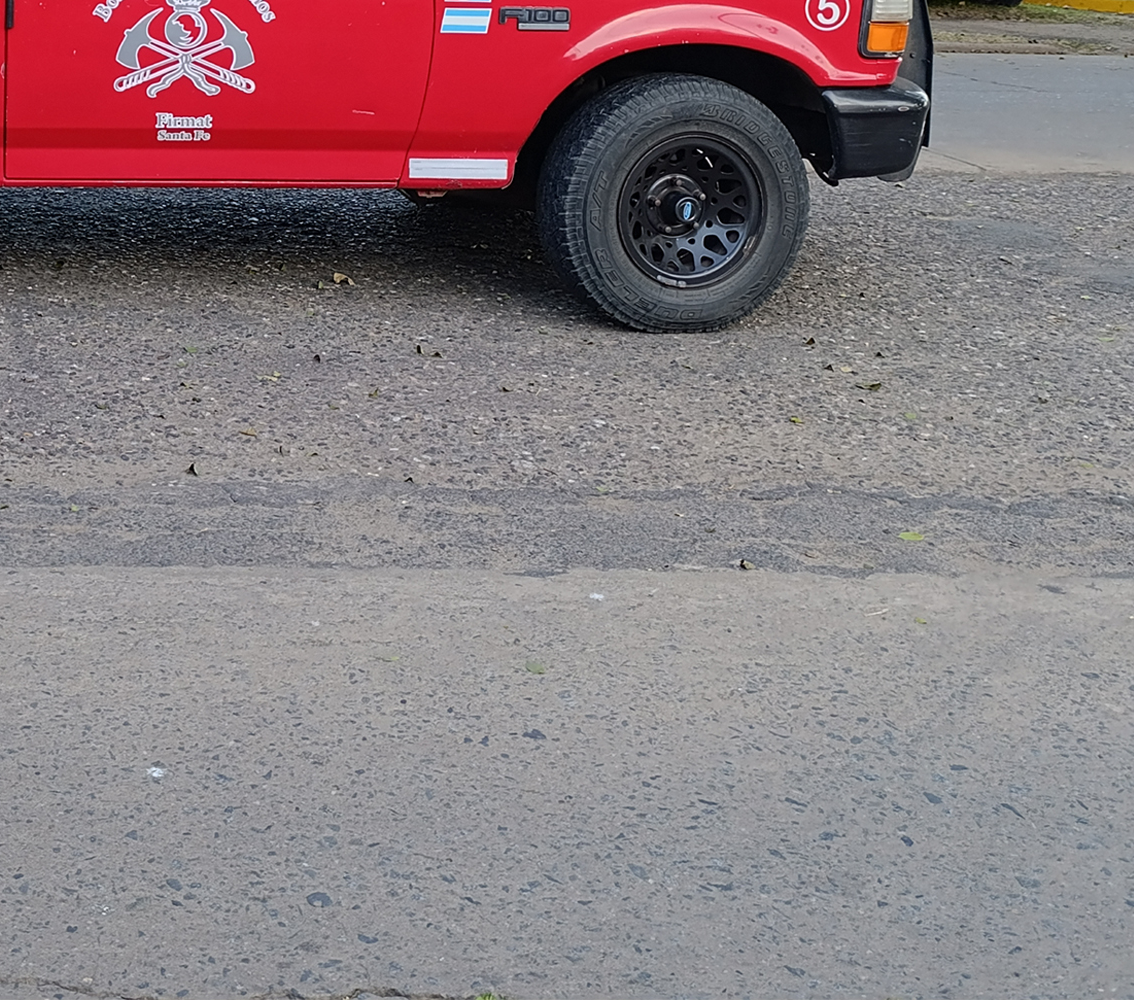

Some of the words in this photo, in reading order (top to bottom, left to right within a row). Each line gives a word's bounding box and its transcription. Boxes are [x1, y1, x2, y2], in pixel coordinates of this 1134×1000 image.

[155, 112, 213, 128] Firmat
[157, 130, 193, 141] Santa
[193, 130, 211, 141] Fe
